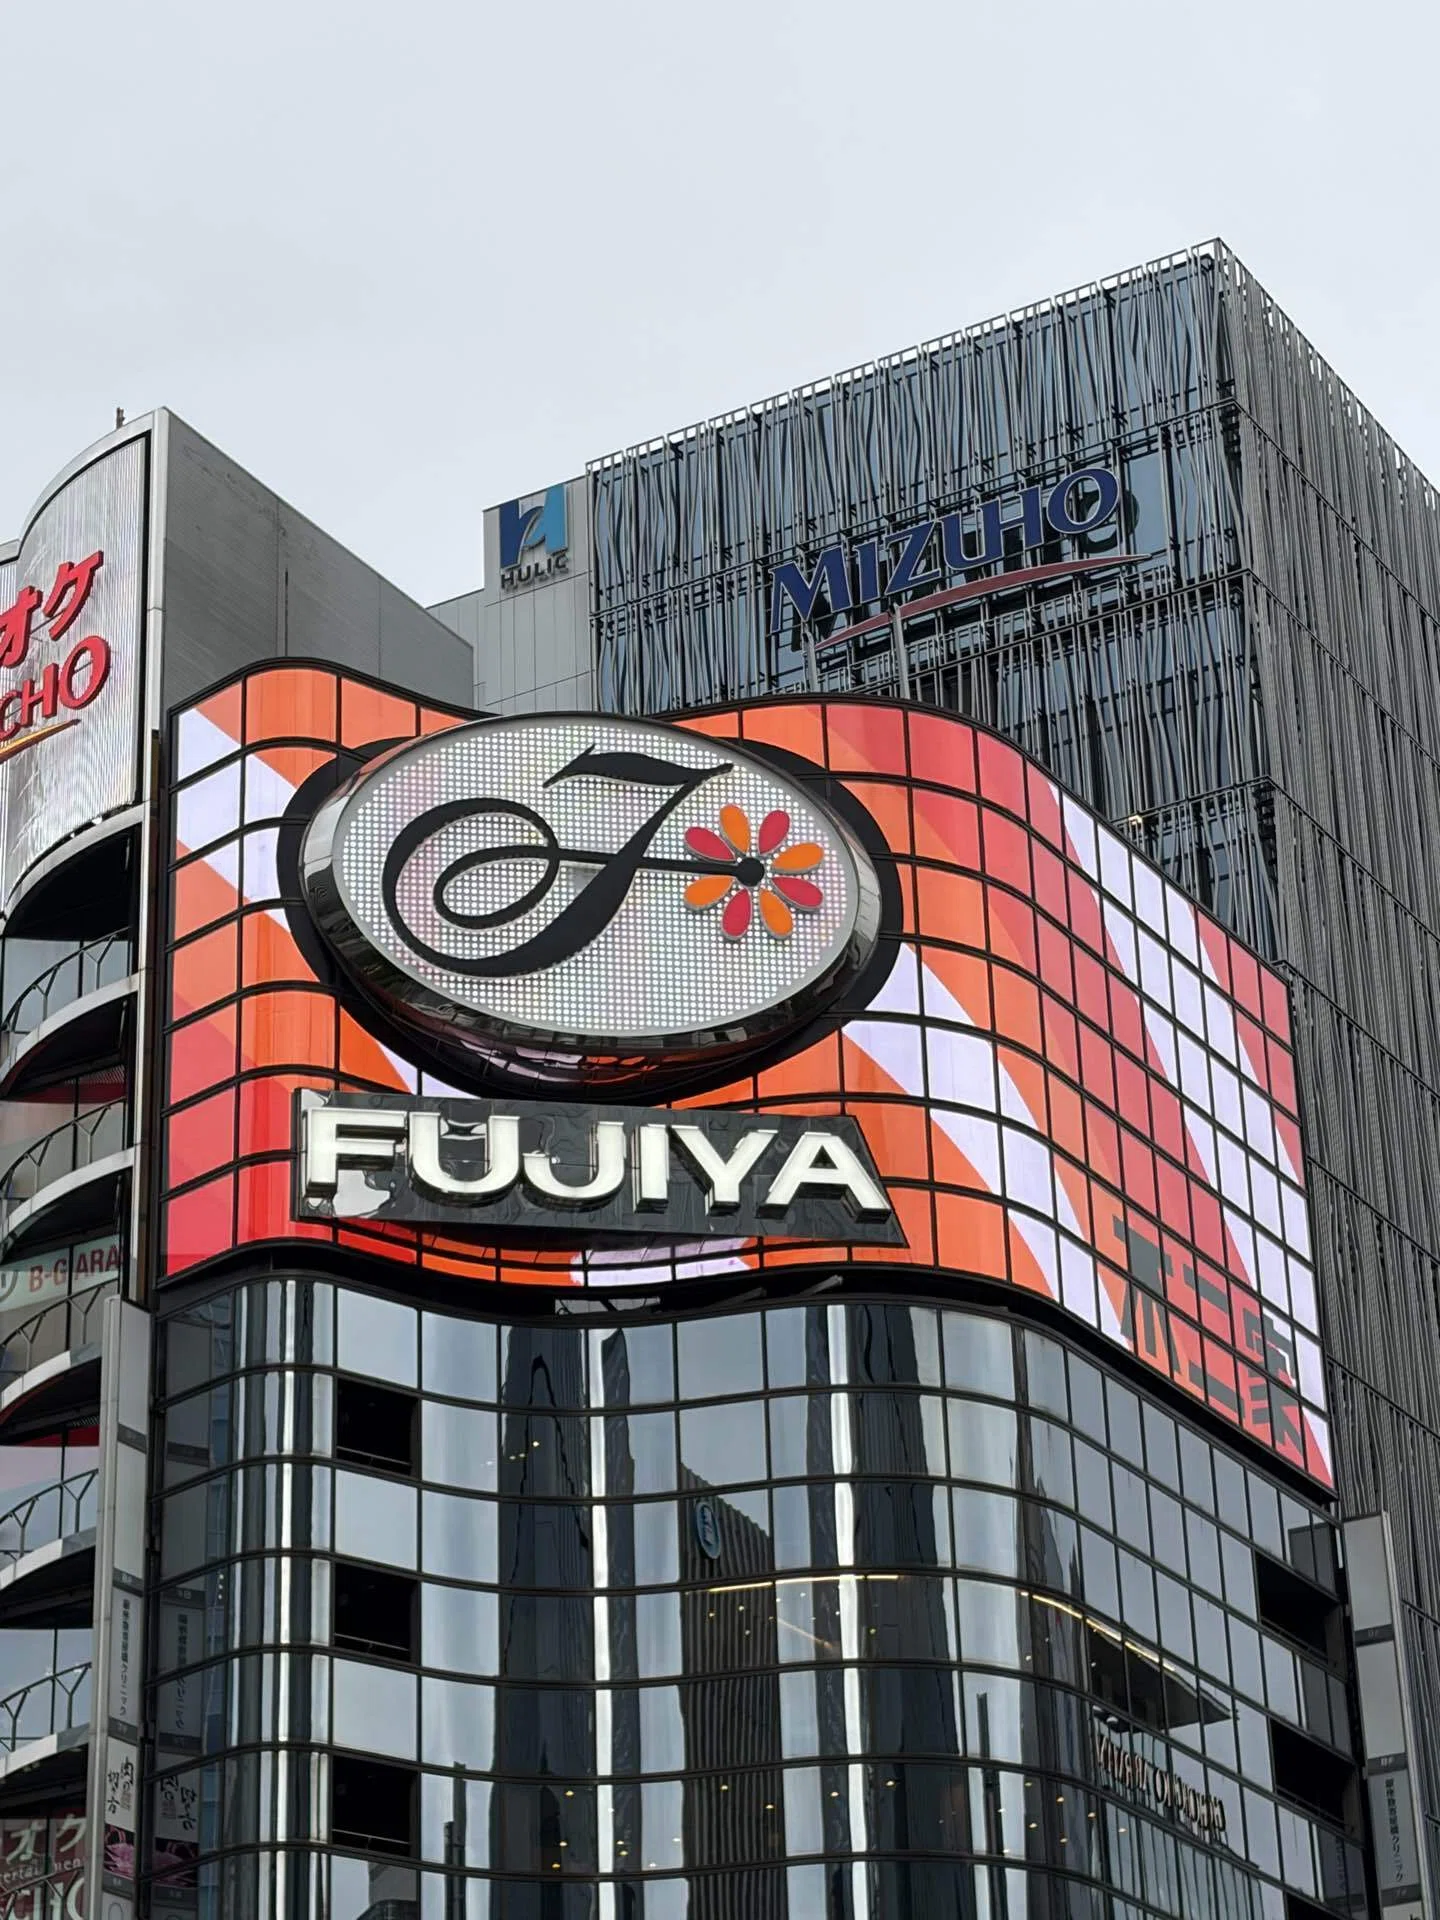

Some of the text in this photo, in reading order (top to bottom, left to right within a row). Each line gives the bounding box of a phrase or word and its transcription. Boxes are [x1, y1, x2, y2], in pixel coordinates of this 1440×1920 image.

[501, 553, 569, 590] HULIC
[768, 467, 1120, 634] MIZUHO
[302, 1107, 892, 1224] FUJIYA
[1112, 1214, 1305, 1459] 不二家
